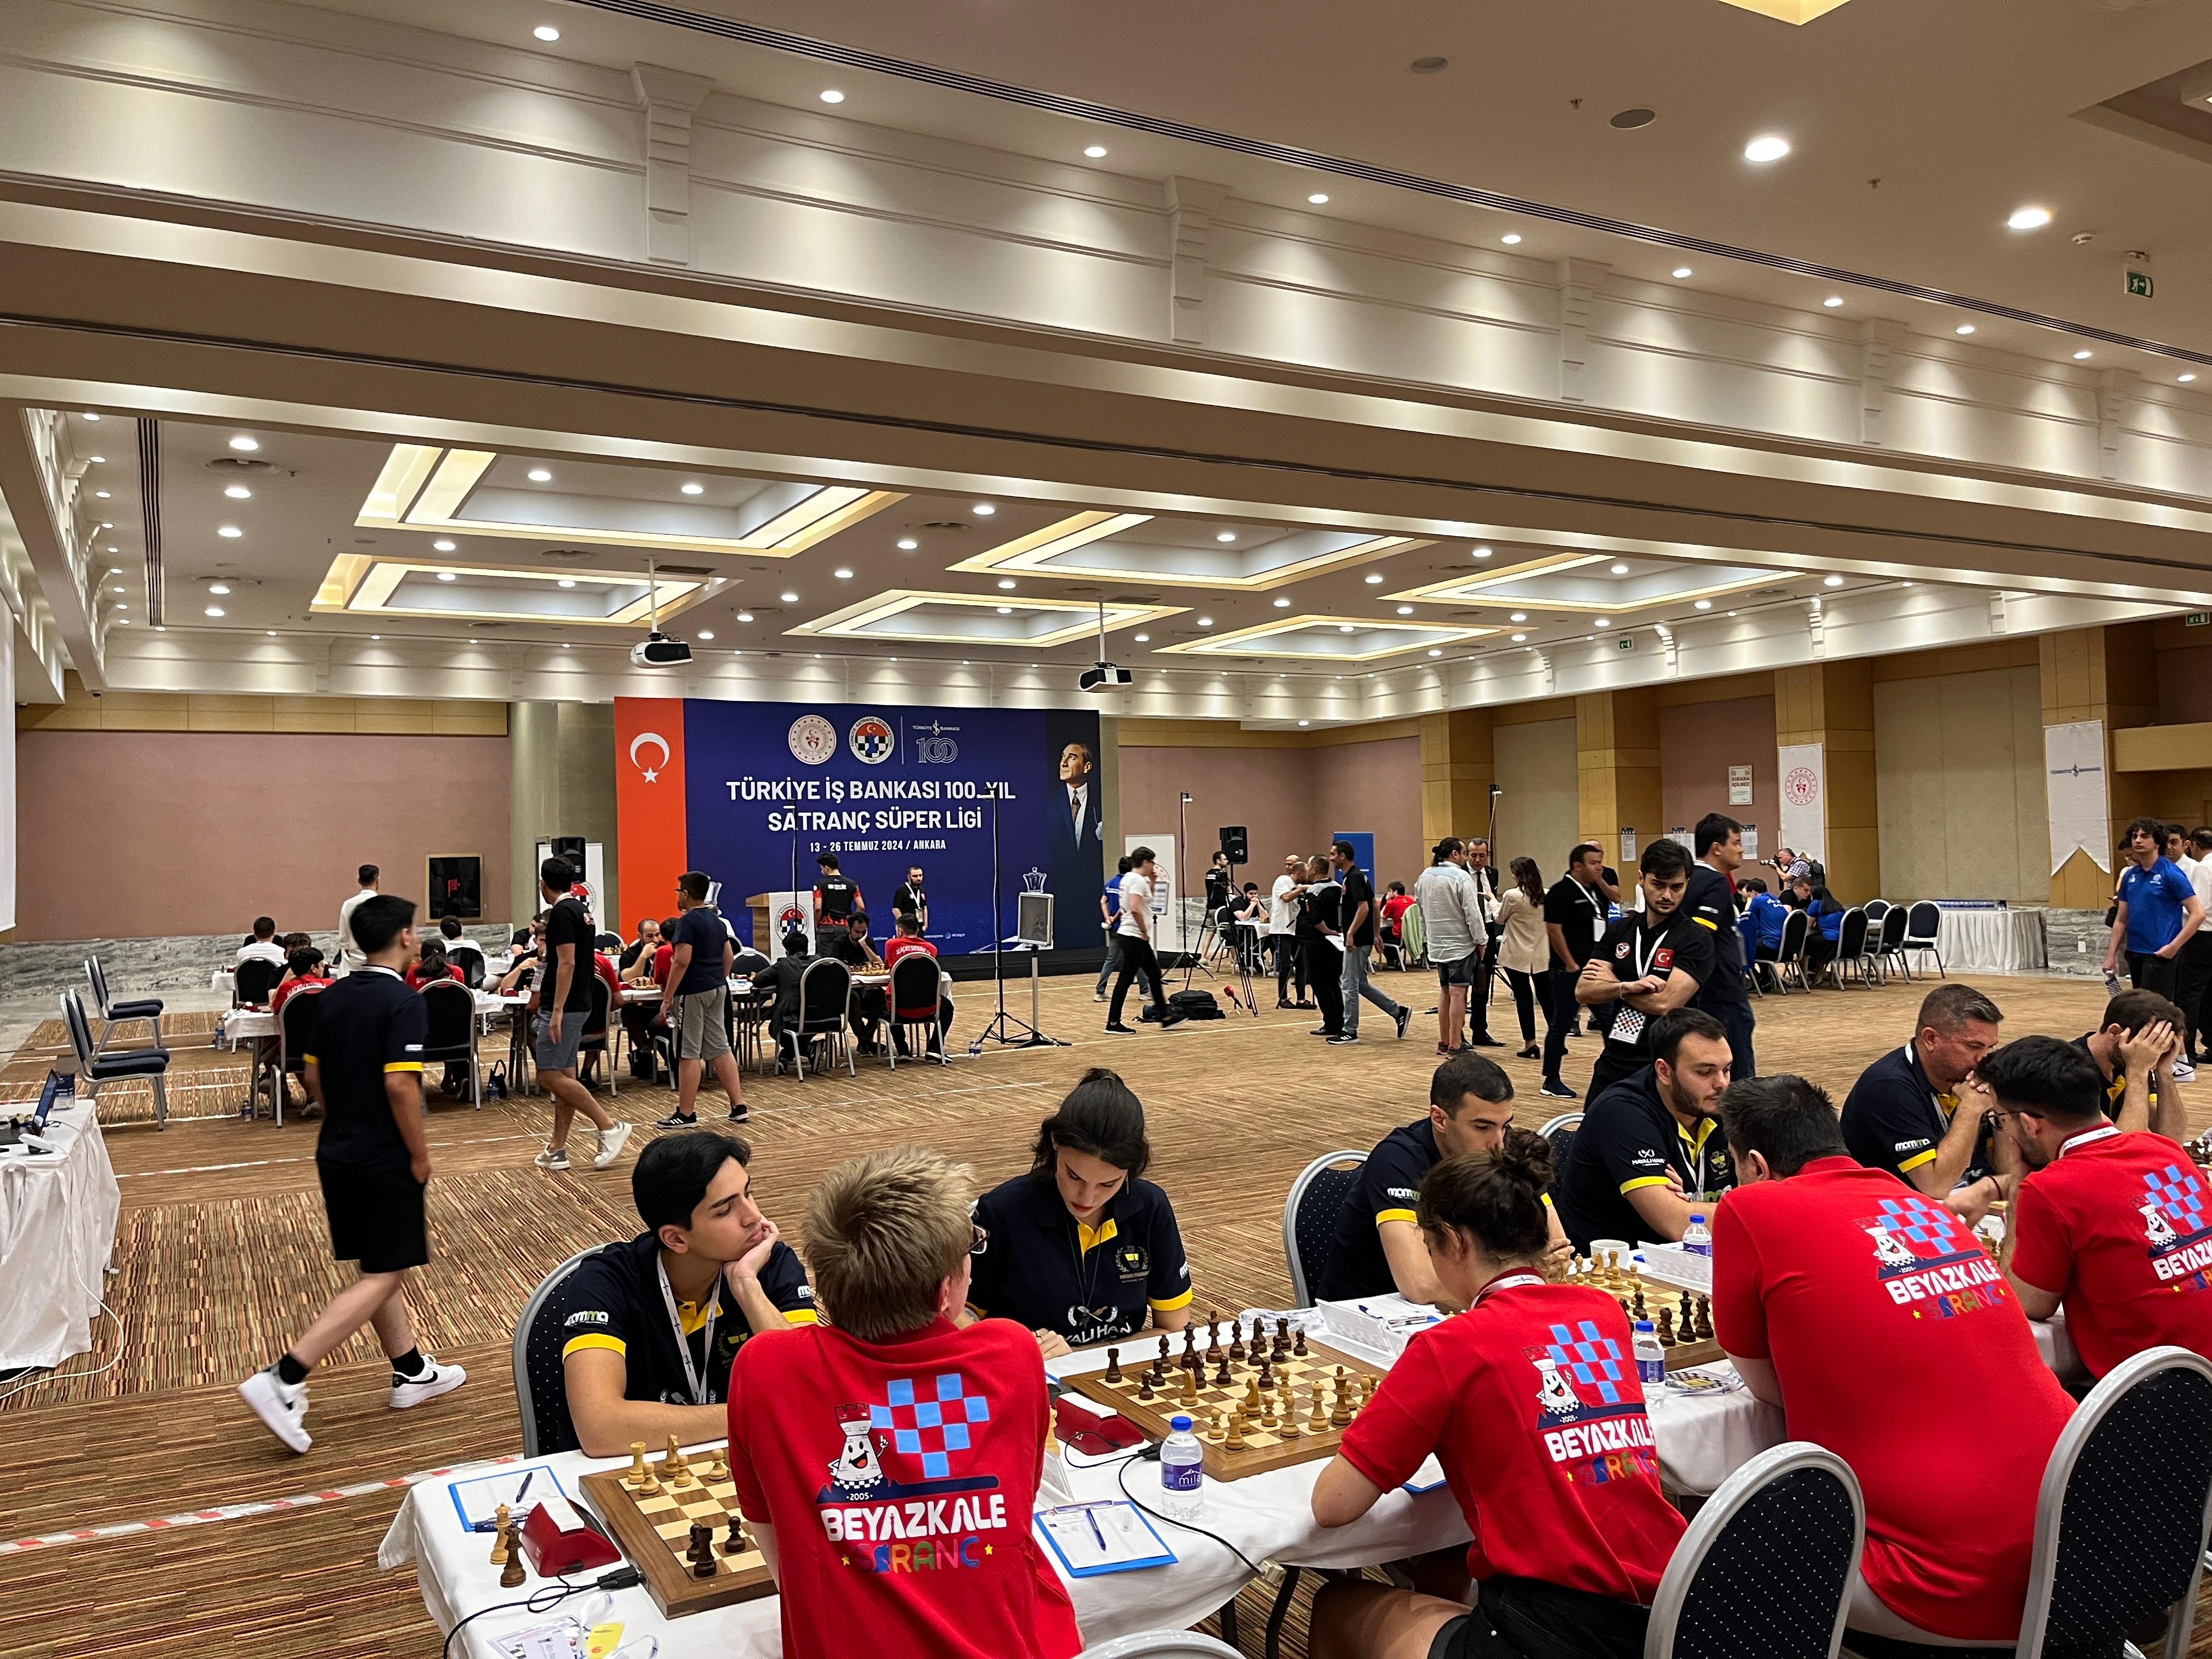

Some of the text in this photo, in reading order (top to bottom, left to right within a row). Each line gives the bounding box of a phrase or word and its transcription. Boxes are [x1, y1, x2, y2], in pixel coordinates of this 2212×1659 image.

[916, 737, 958, 763] 100
[726, 776, 821, 800] TÜRKİYE
[825, 776, 845, 804] İŞ
[850, 781, 940, 799] BANKASI
[986, 781, 1016, 799] YIL
[768, 806, 981, 834] SATRANÇ SÜPER LİGİ
[810, 842, 820, 852] 13
[830, 842, 841, 851] 26
[843, 840, 879, 851] TEMMUZ
[882, 840, 903, 850] 2024
[905, 840, 911, 850] /
[913, 839, 946, 850] ANKARA
[1387, 1188, 1420, 1200] mamm
[1884, 1259, 2002, 1305] BEYAZKALE
[1561, 1415, 1576, 1424] 2005
[849, 1492, 869, 1501] 2005
[821, 1494, 1007, 1542] BEYAZKALE
